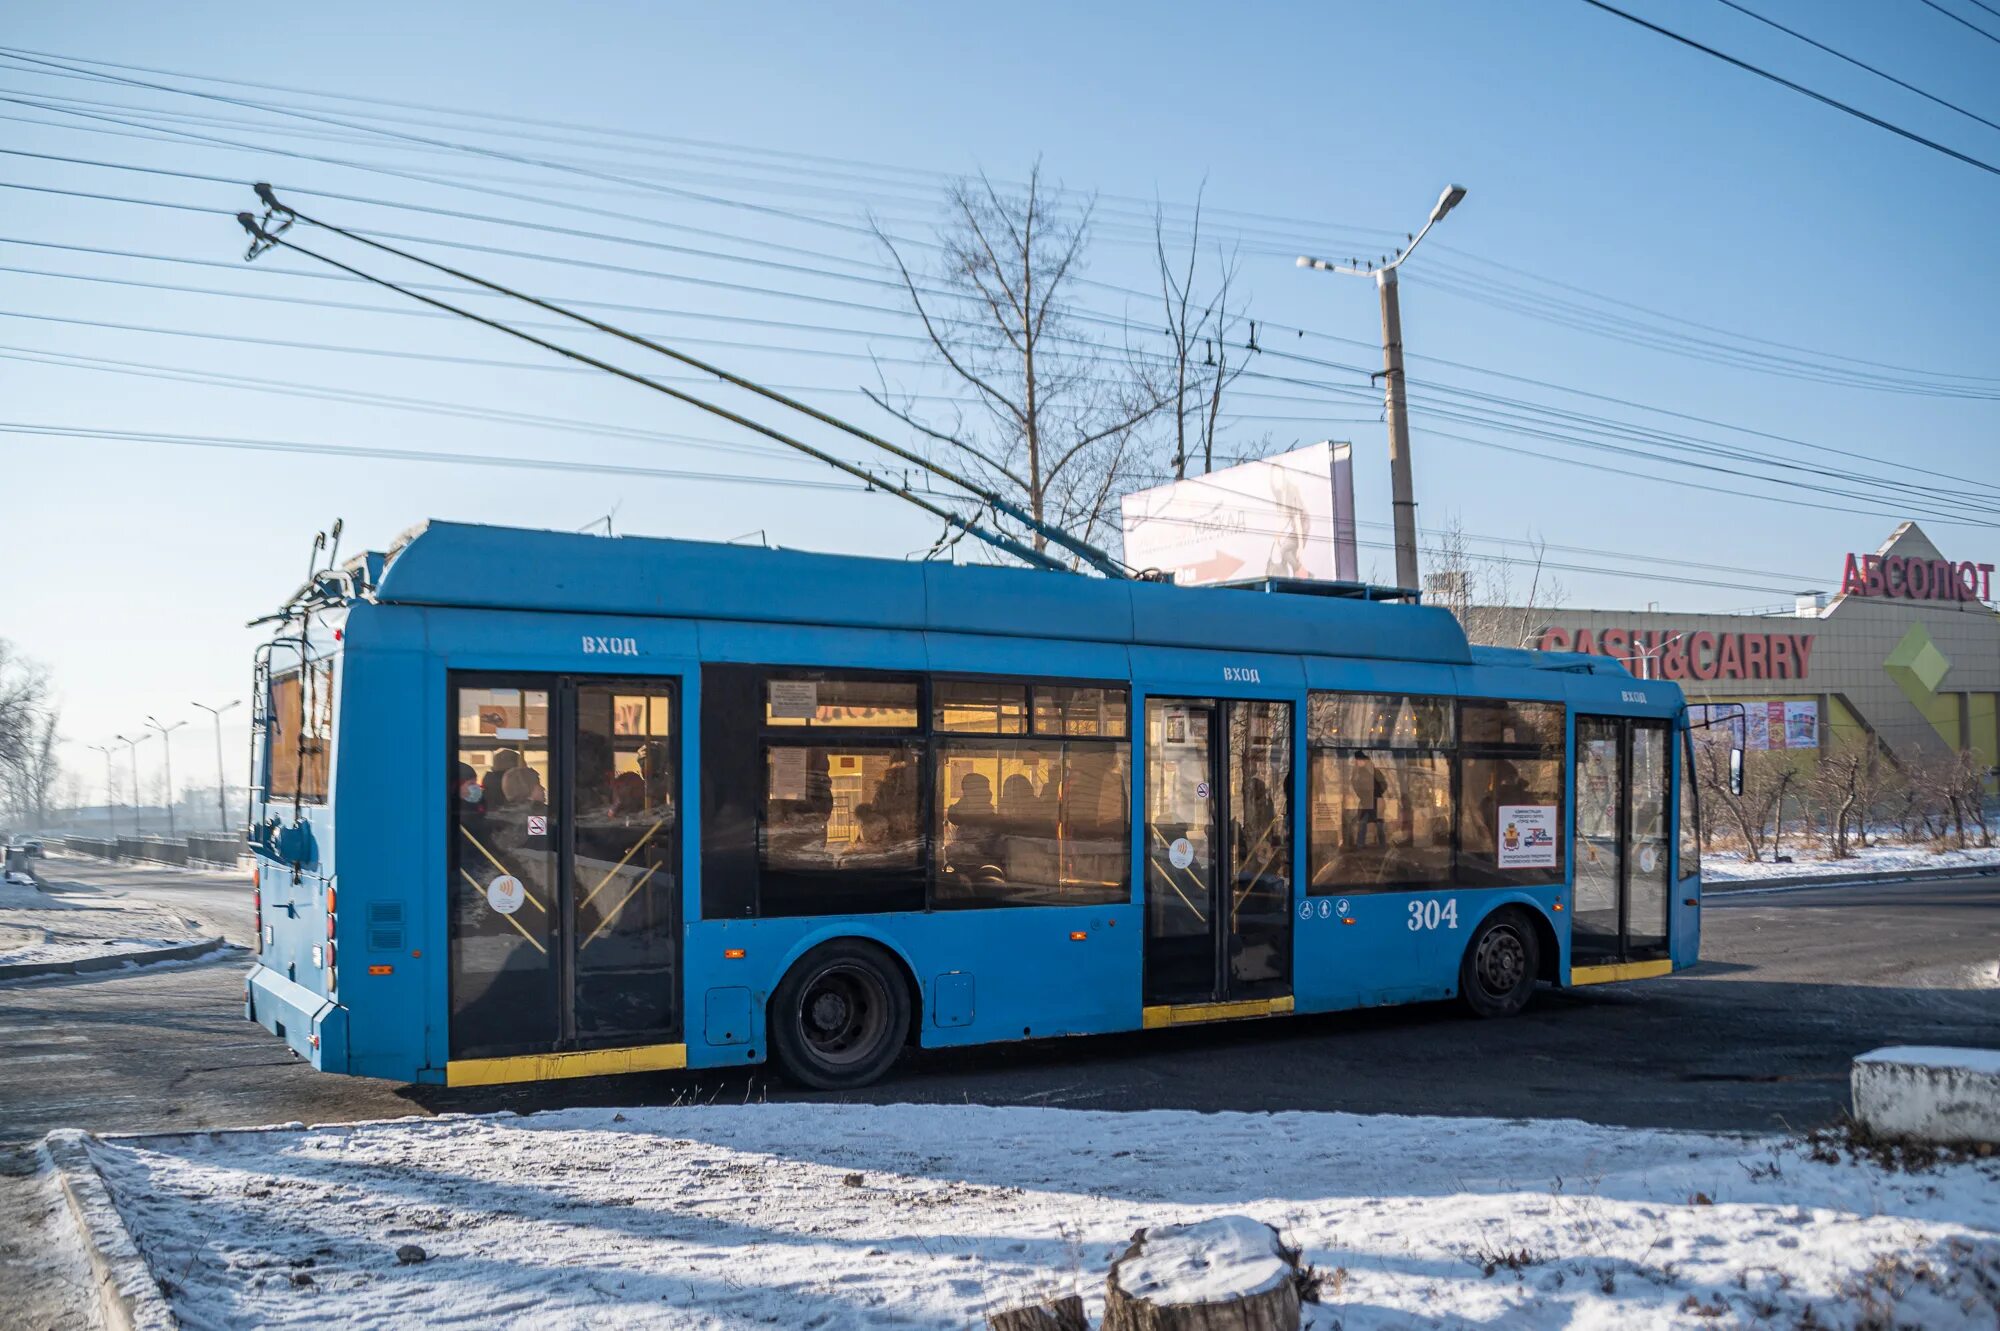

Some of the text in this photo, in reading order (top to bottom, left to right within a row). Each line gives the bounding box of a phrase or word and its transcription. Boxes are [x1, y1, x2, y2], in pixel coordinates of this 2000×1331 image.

[1841, 553, 1995, 602] АБСОЛЮТ
[582, 636, 639, 656] ВХОД
[1223, 667, 1261, 683] ВХОД
[1621, 690, 1648, 704] ВХОД
[1407, 898, 1458, 931] 304
